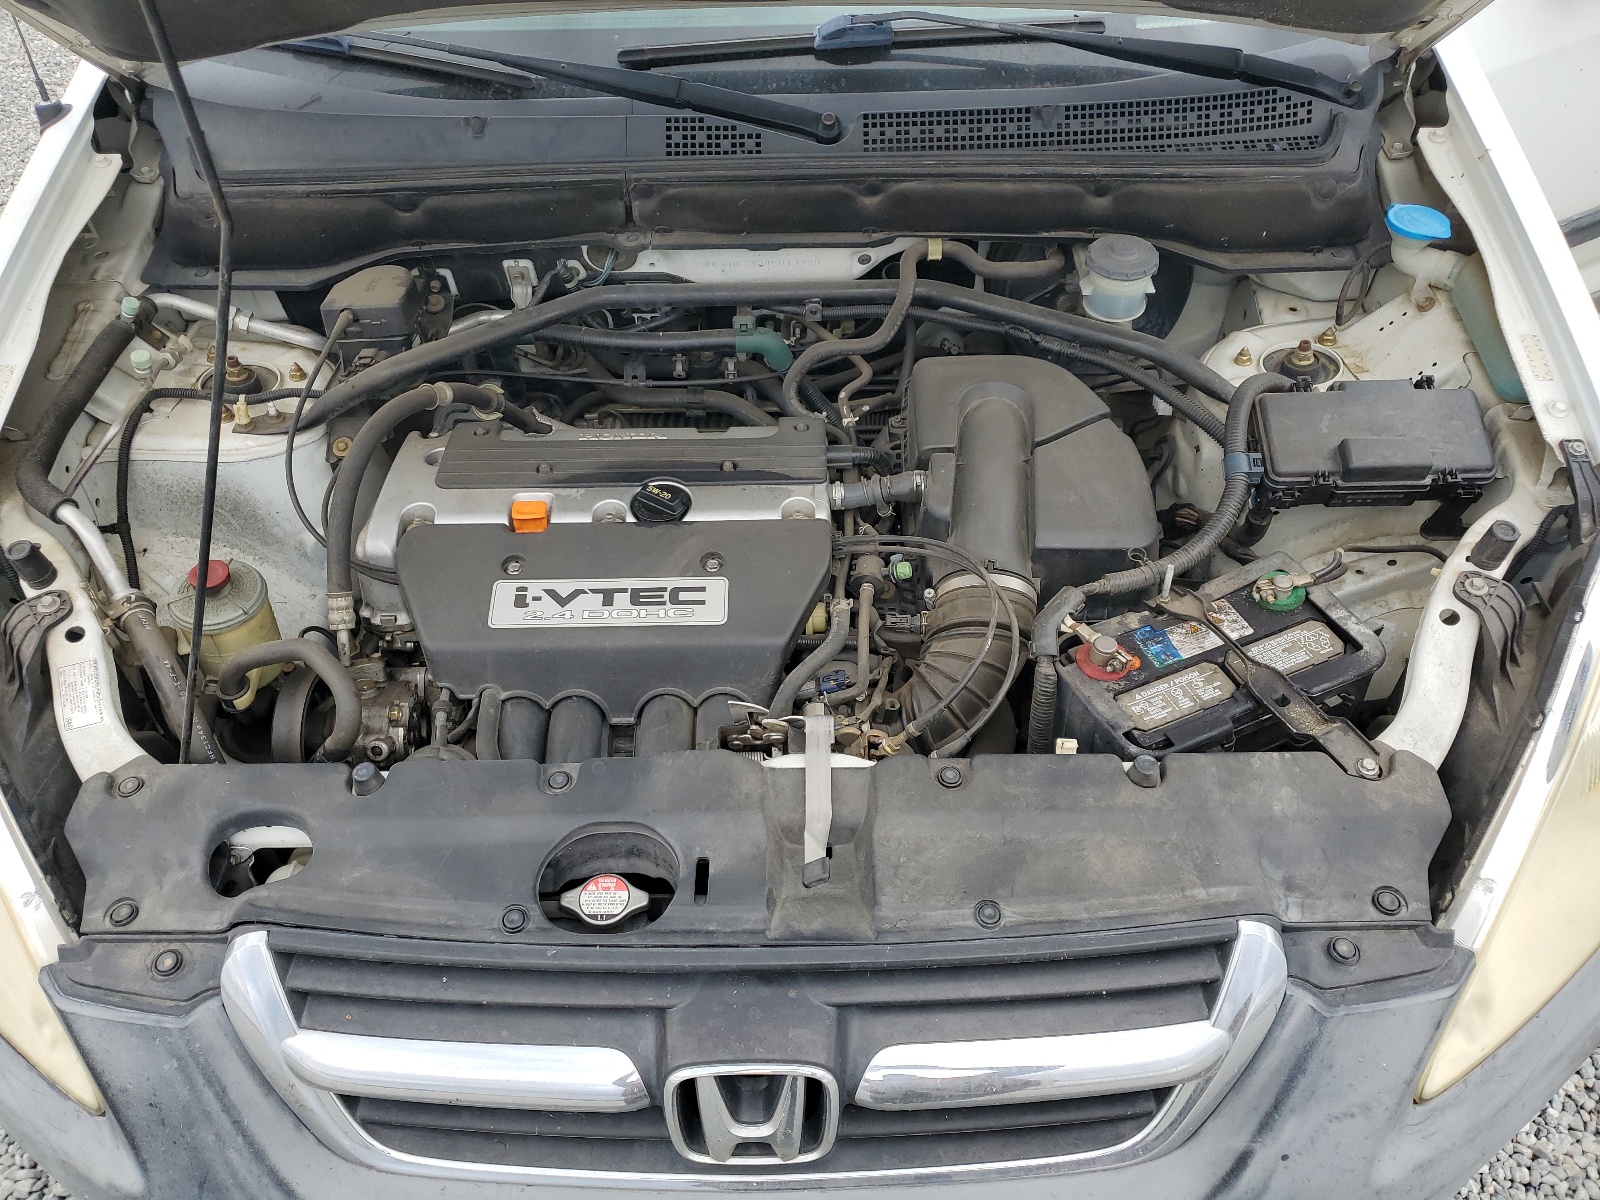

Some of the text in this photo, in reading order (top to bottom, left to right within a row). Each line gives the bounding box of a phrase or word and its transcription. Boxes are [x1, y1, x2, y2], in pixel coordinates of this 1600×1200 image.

[646, 485, 672, 499] 5W-20
[513, 586, 707, 608] i-VTEC
[523, 608, 695, 620] 2.4 DOHC
[1141, 683, 1170, 699] DANGER
[1174, 671, 1200, 685] POISON
